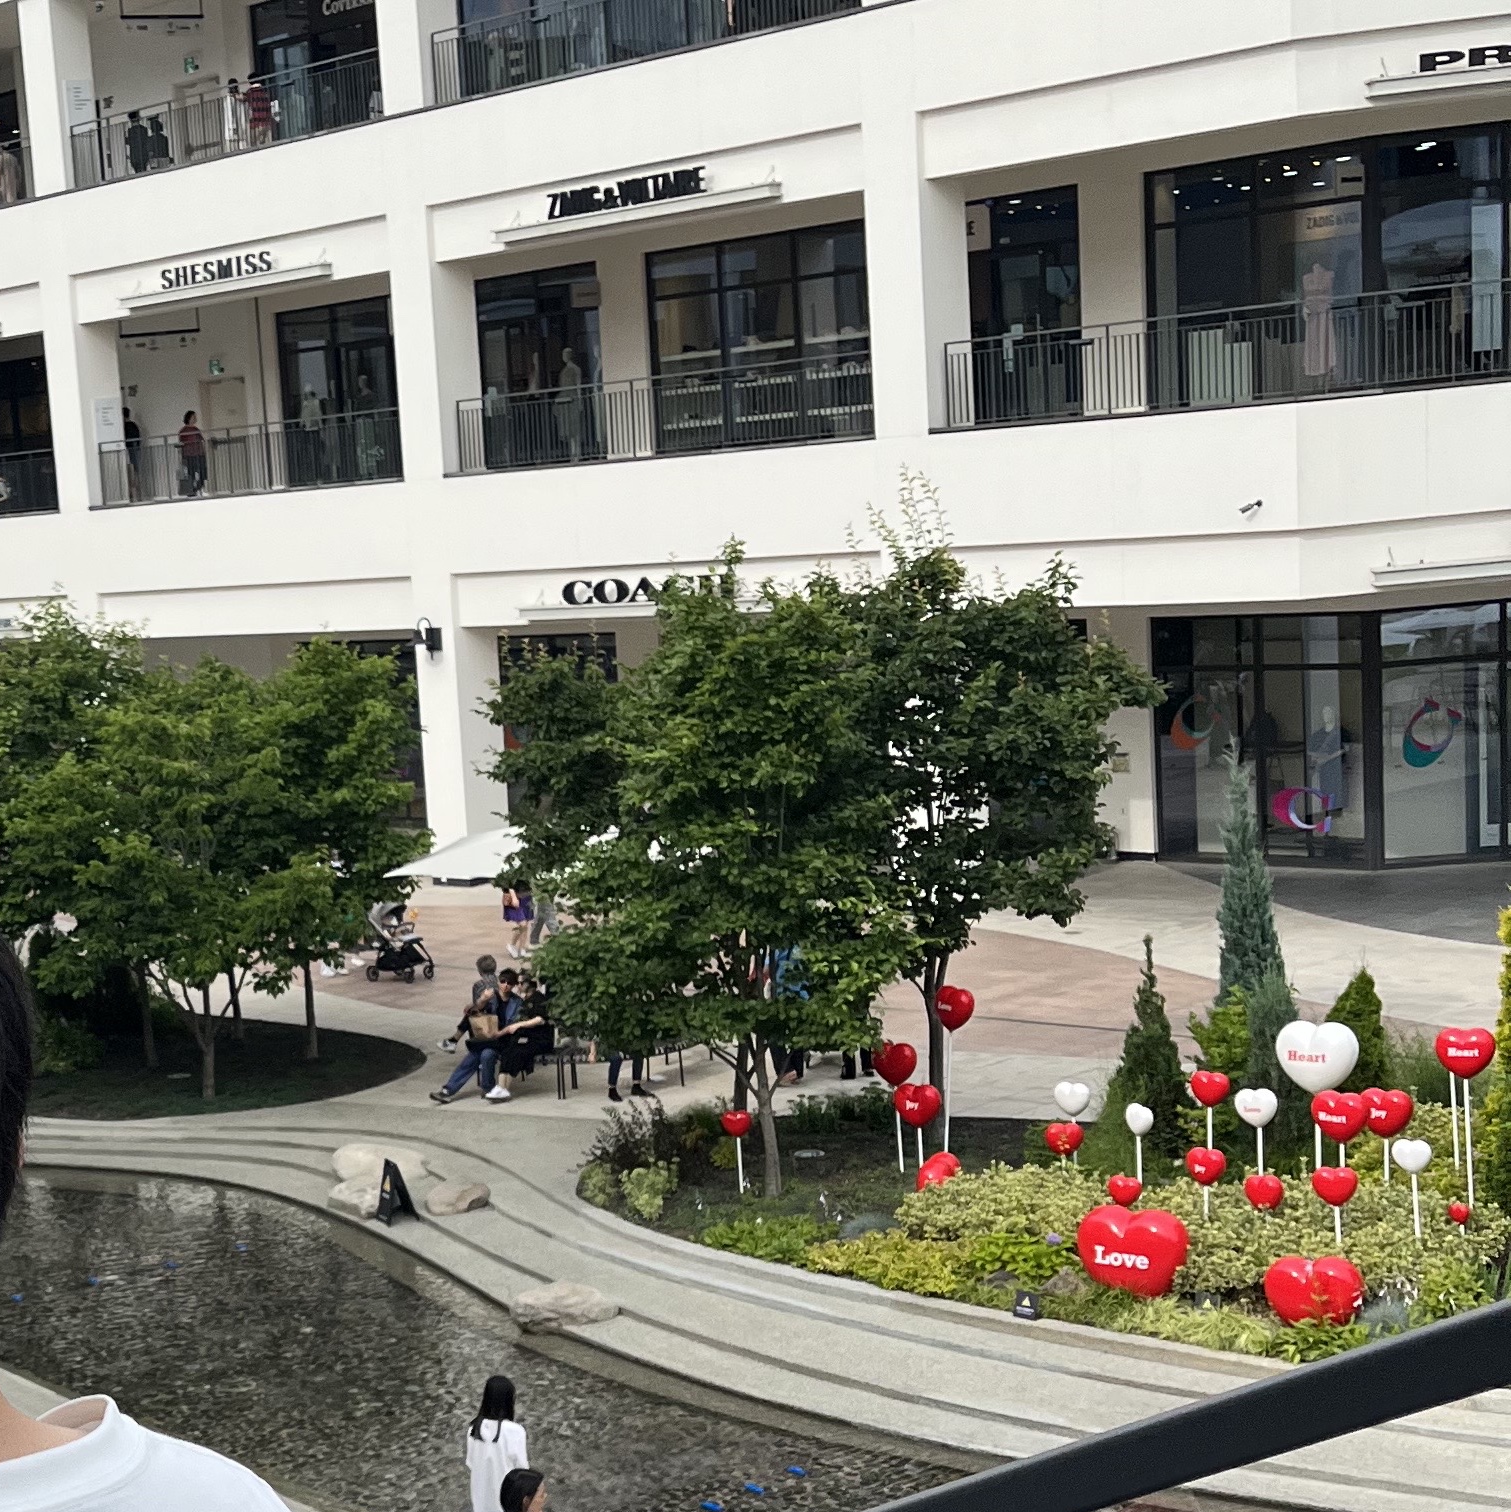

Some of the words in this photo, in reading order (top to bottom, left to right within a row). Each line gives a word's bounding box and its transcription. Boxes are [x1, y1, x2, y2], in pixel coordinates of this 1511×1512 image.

[161, 251, 272, 290] SHESMISS
[562, 574, 735, 605] COA
[1287, 1050, 1326, 1063] Heart
[1447, 1047, 1479, 1058] Heart
[1318, 1111, 1347, 1124] Heart
[1370, 1107, 1387, 1119] Joy
[1094, 1245, 1149, 1270] Love
